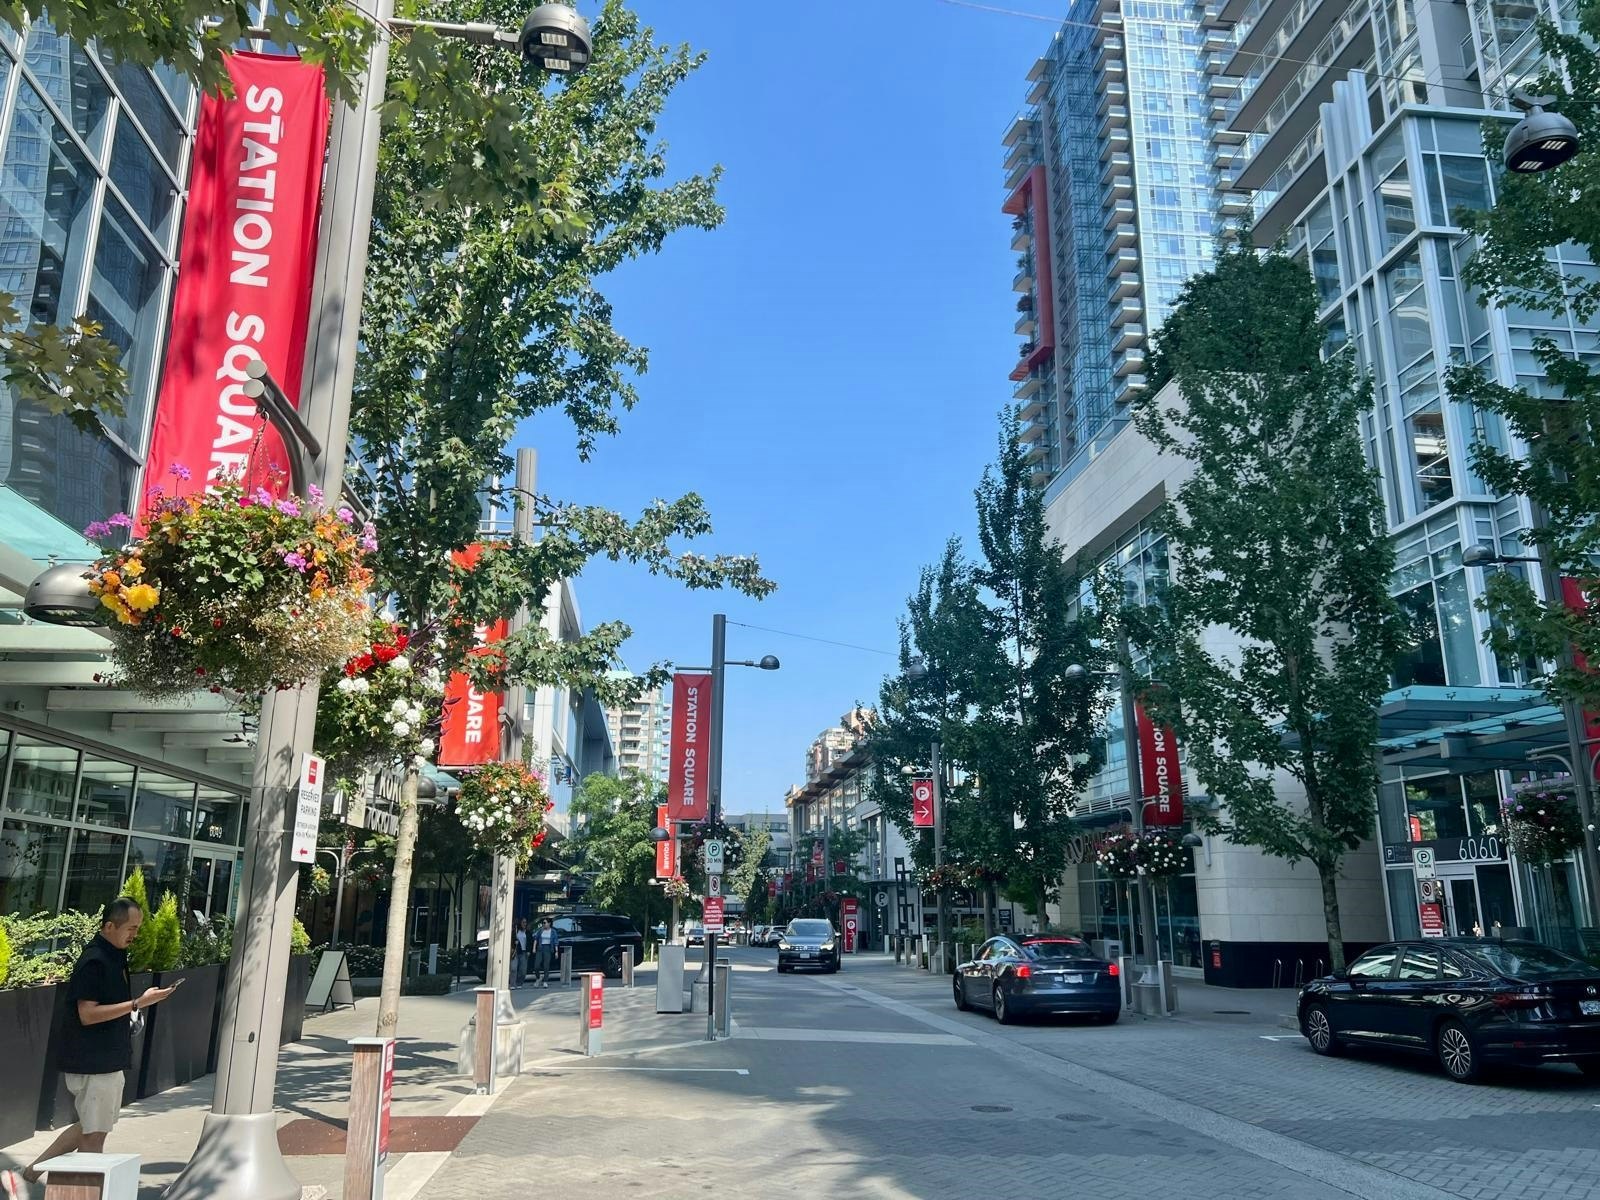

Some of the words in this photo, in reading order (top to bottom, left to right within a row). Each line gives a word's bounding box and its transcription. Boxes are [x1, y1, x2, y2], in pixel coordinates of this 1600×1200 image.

[230, 84, 285, 288] STATION
[204, 311, 266, 496] SQUAR
[686, 687, 698, 742] STATION
[683, 748, 696, 806] SQUARE
[1156, 756, 1170, 813] SQUARE
[1459, 837, 1499, 860] 6060
